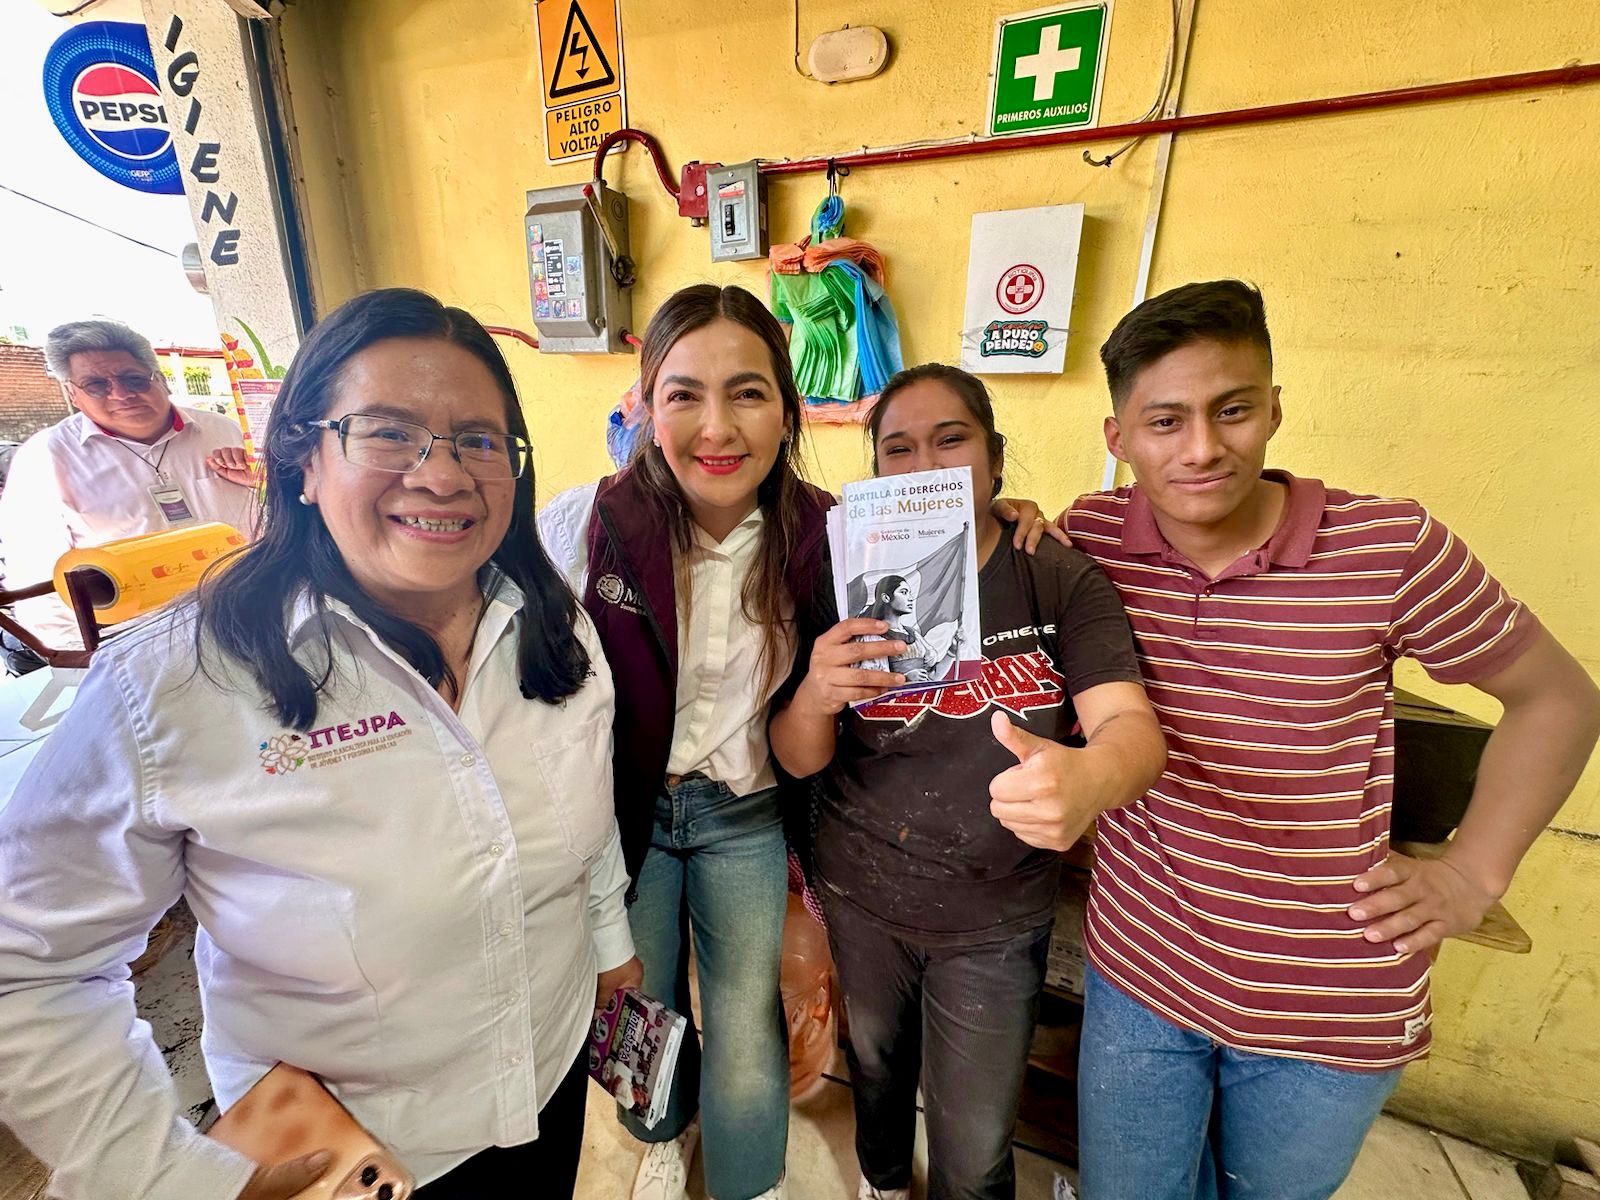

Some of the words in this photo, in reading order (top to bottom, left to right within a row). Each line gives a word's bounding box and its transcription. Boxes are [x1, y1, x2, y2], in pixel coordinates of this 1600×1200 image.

[79, 99, 169, 125] PEPSI
[556, 100, 611, 123] PELIGRO
[996, 109, 1042, 124] PRIMEROS
[1043, 102, 1088, 118] AUXILIOS
[569, 118, 599, 136] ALTO
[990, 329, 1000, 341] A
[1002, 328, 1039, 341] PURO
[847, 489, 892, 503] CARTILLA
[894, 487, 907, 497] DE
[909, 481, 963, 495] DERECHOS
[848, 505, 866, 519] de
[870, 502, 892, 516] las
[897, 497, 964, 515] Mujeres
[881, 532, 910, 541] México
[918, 528, 945, 536] Mujeres
[306, 710, 406, 750] ITEJPA
[367, 737, 380, 746] PARA
